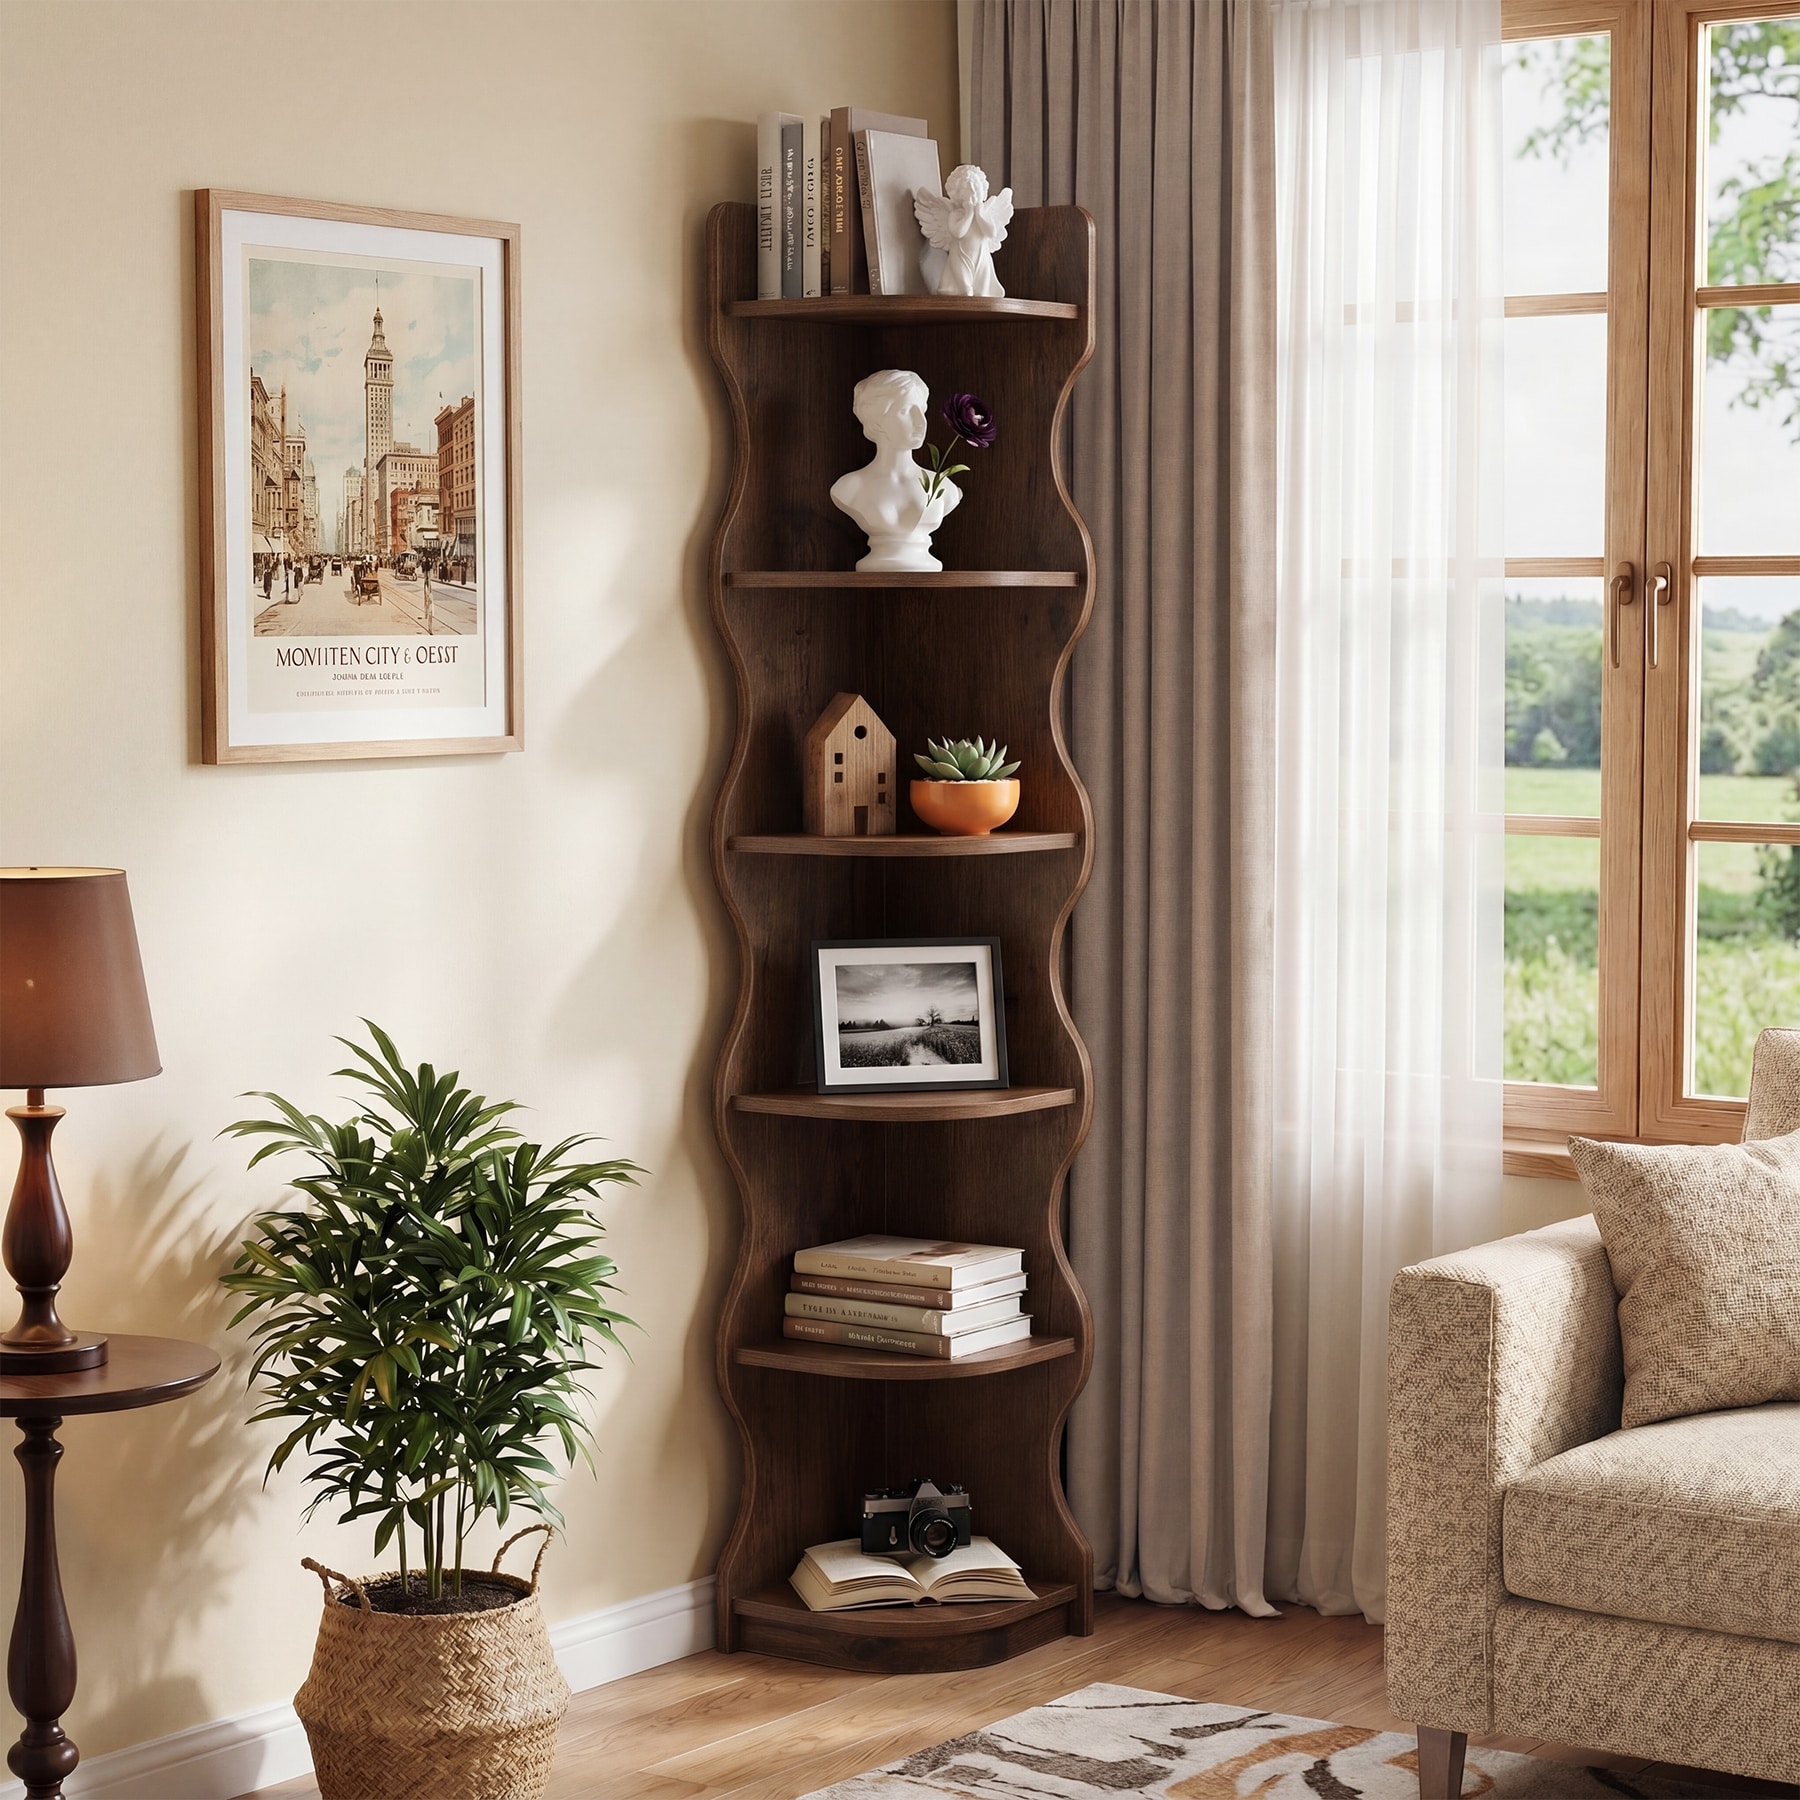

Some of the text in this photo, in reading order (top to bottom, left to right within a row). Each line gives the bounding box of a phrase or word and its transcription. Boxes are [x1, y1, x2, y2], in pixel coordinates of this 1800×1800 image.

[365, 646, 400, 665] CITY
[404, 648, 411, 664] &
[416, 646, 459, 664] OESST
